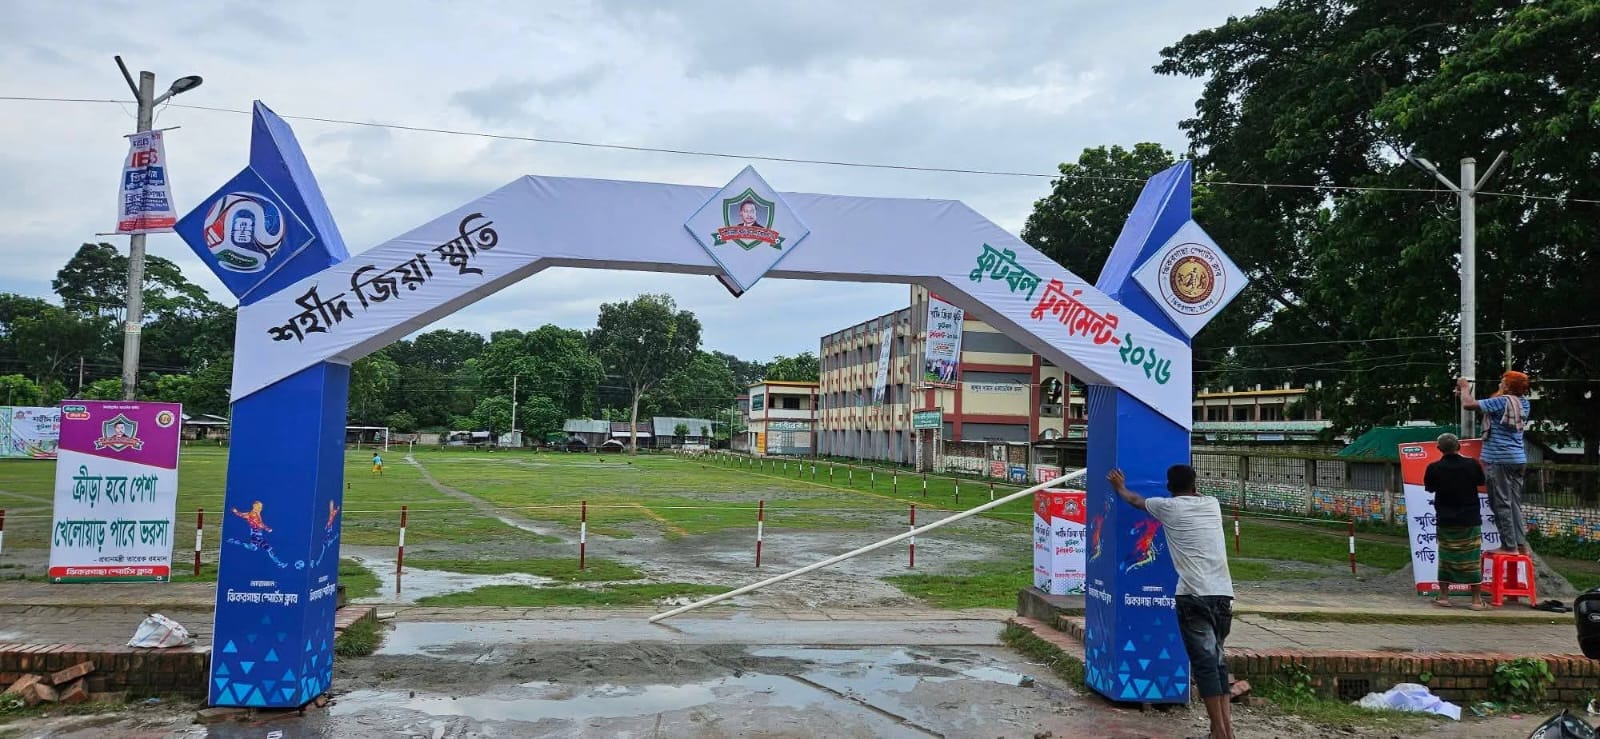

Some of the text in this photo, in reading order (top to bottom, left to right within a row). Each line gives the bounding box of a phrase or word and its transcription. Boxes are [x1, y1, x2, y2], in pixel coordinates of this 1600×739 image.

[267, 212, 499, 343] শহীদ জিয়া স্মৃতি
[969, 242, 1171, 385] ফুটবল টুর্নামেন্ট-২০২৬
[72, 465, 158, 508] ক্রীড়া হবে পেশা
[55, 517, 169, 552] খেলোয়াড় পাবে ভরসা
[227, 589, 298, 606] ঝিকরগাছা স্পোর্টস ক্লাব
